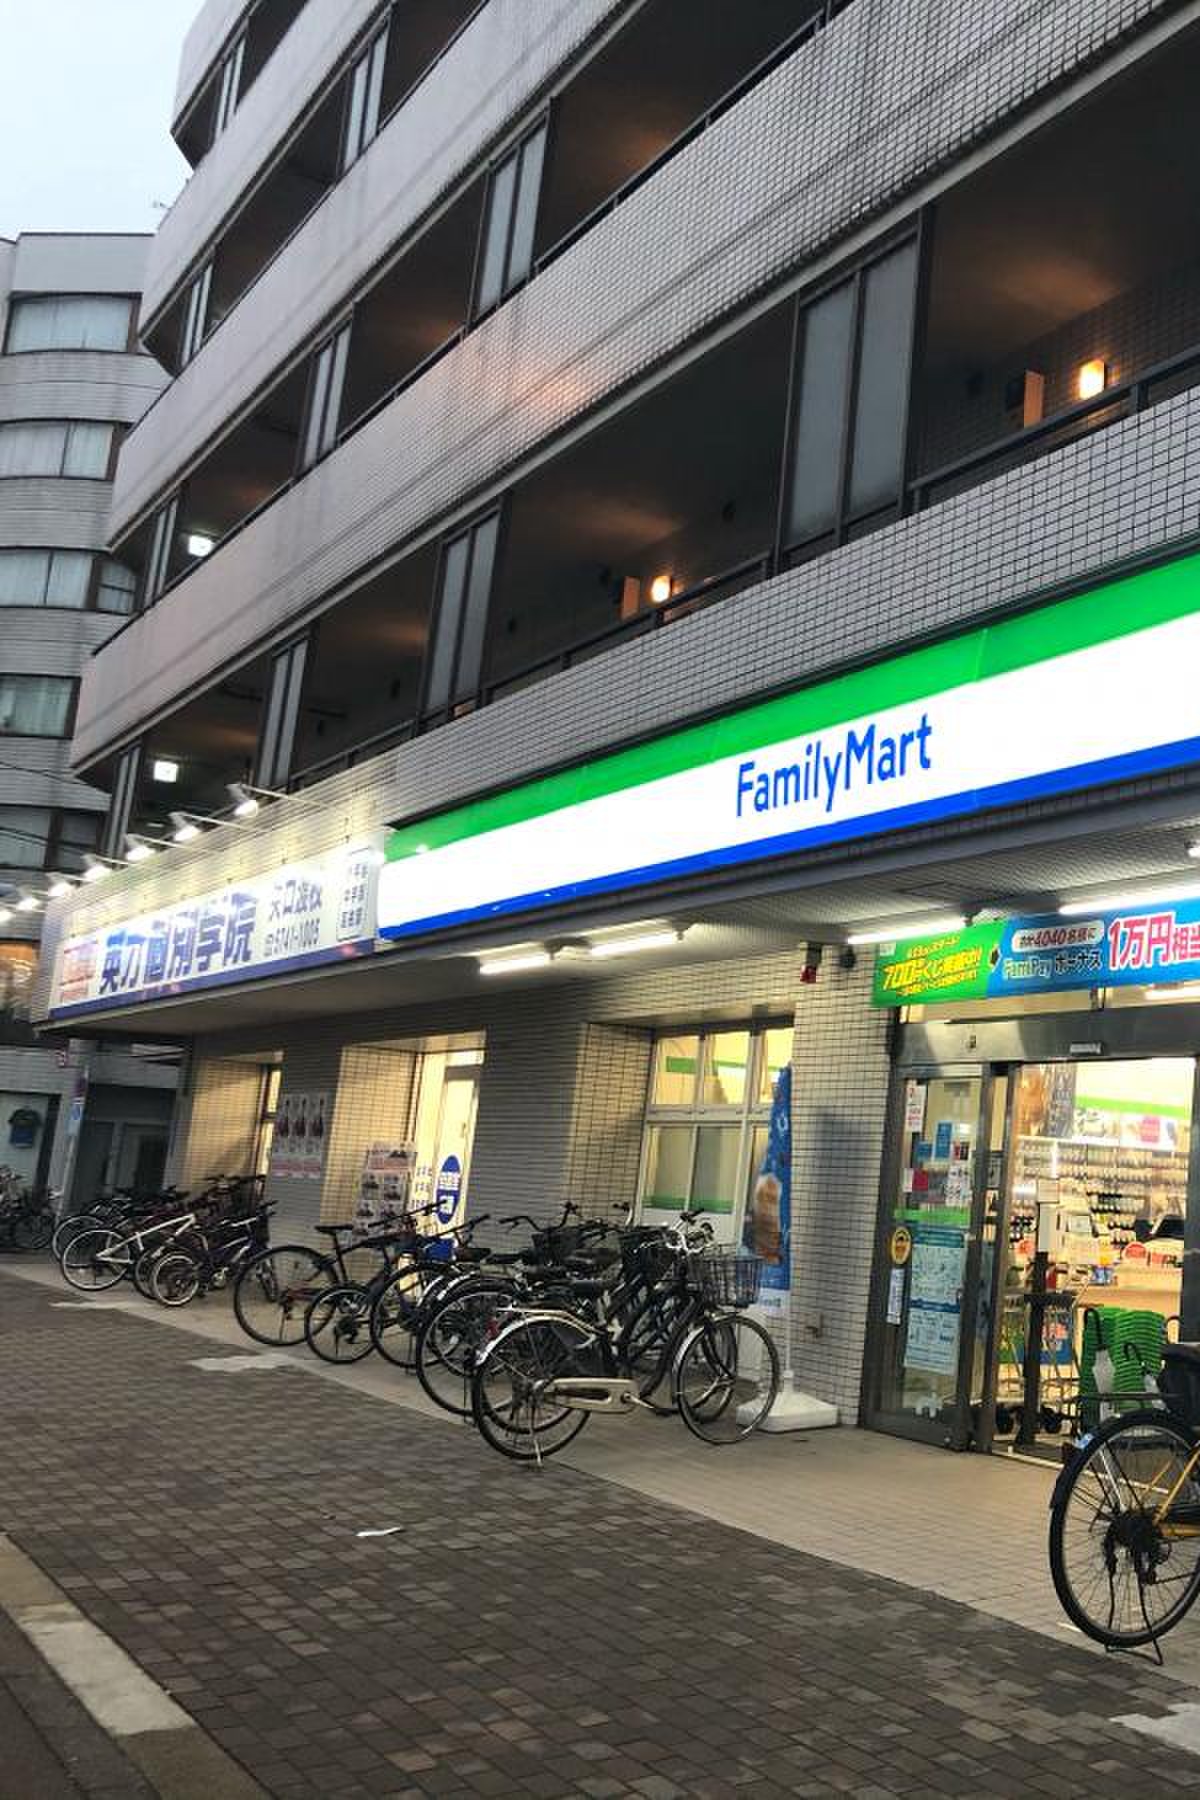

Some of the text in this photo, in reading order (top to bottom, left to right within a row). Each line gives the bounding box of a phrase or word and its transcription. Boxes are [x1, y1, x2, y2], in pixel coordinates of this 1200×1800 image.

[736, 712, 932, 817] FamilyMart
[1055, 948, 1101, 976] ボーナス
